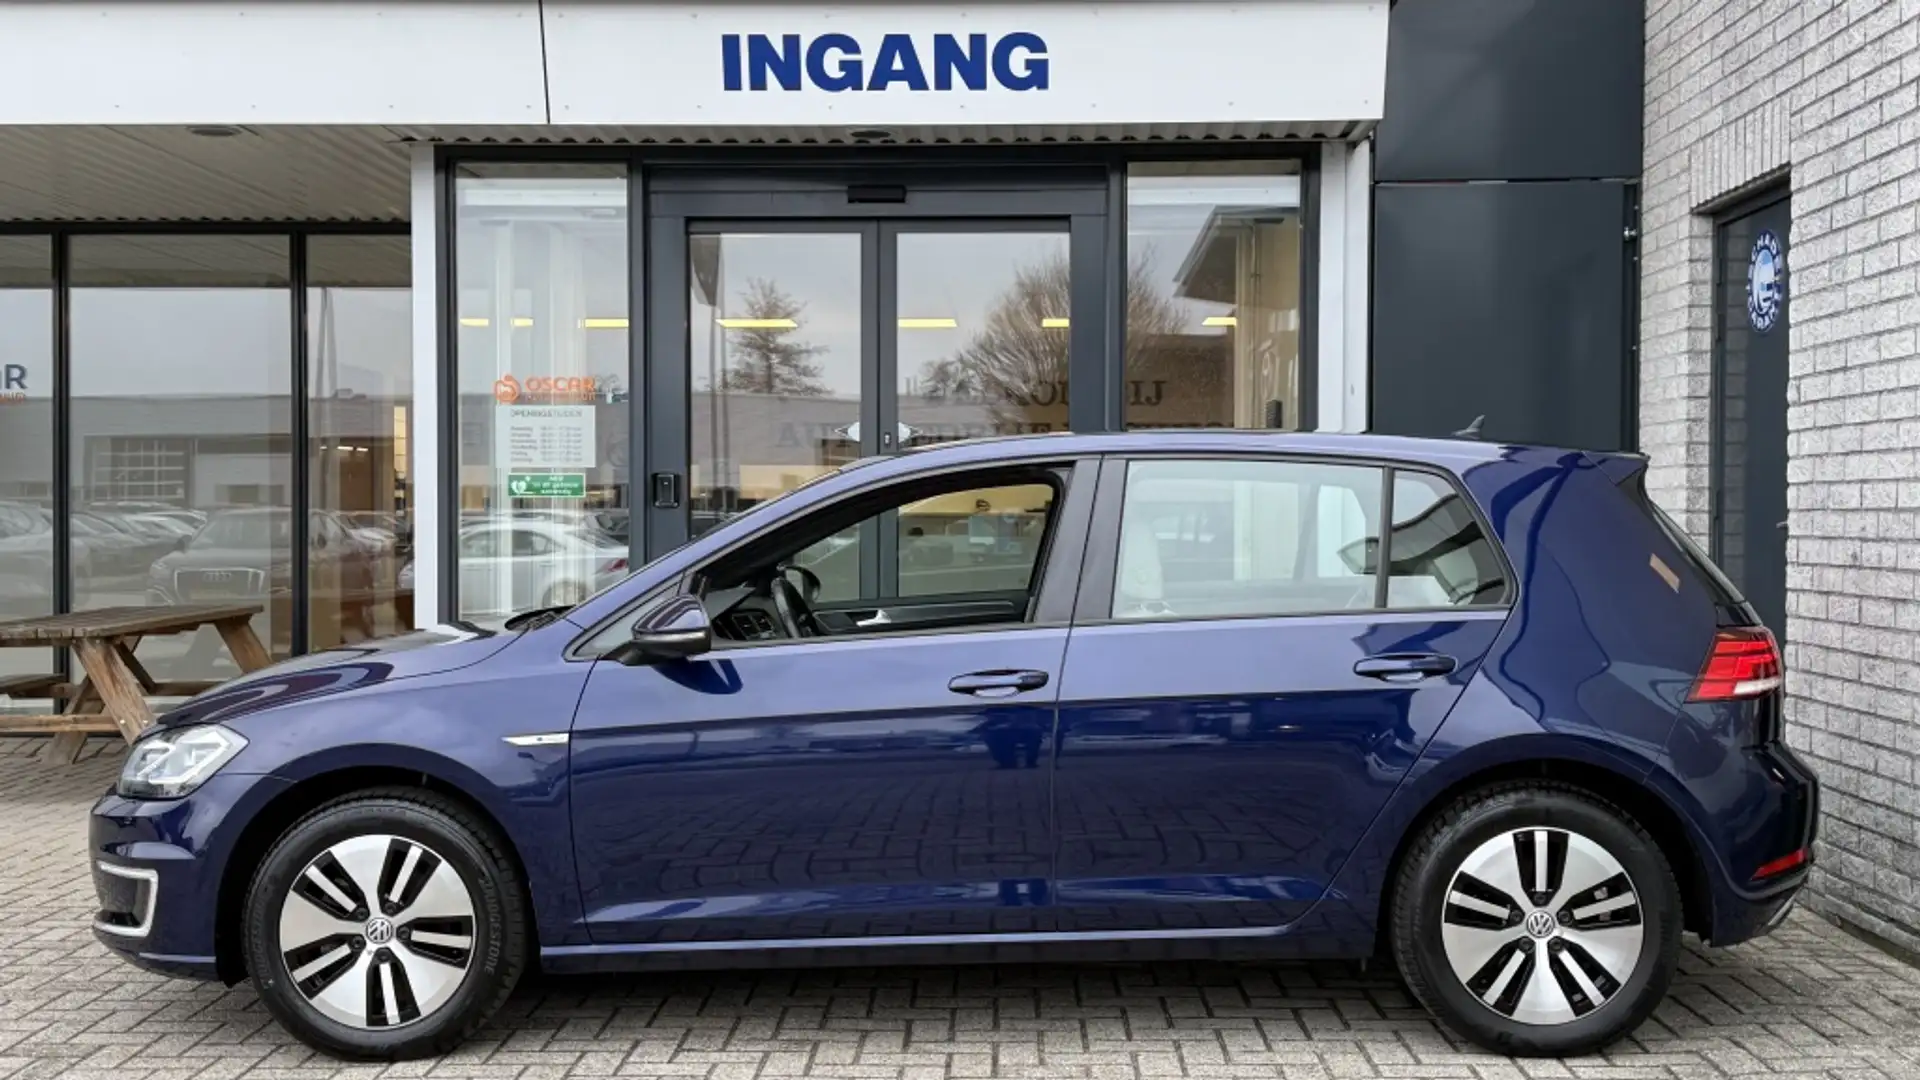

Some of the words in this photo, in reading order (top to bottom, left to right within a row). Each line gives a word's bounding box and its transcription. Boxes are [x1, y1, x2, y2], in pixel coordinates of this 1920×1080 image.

[721, 32, 1049, 92] INGANG
[0, 363, 29, 390] R
[525, 375, 596, 391] OSCAR
